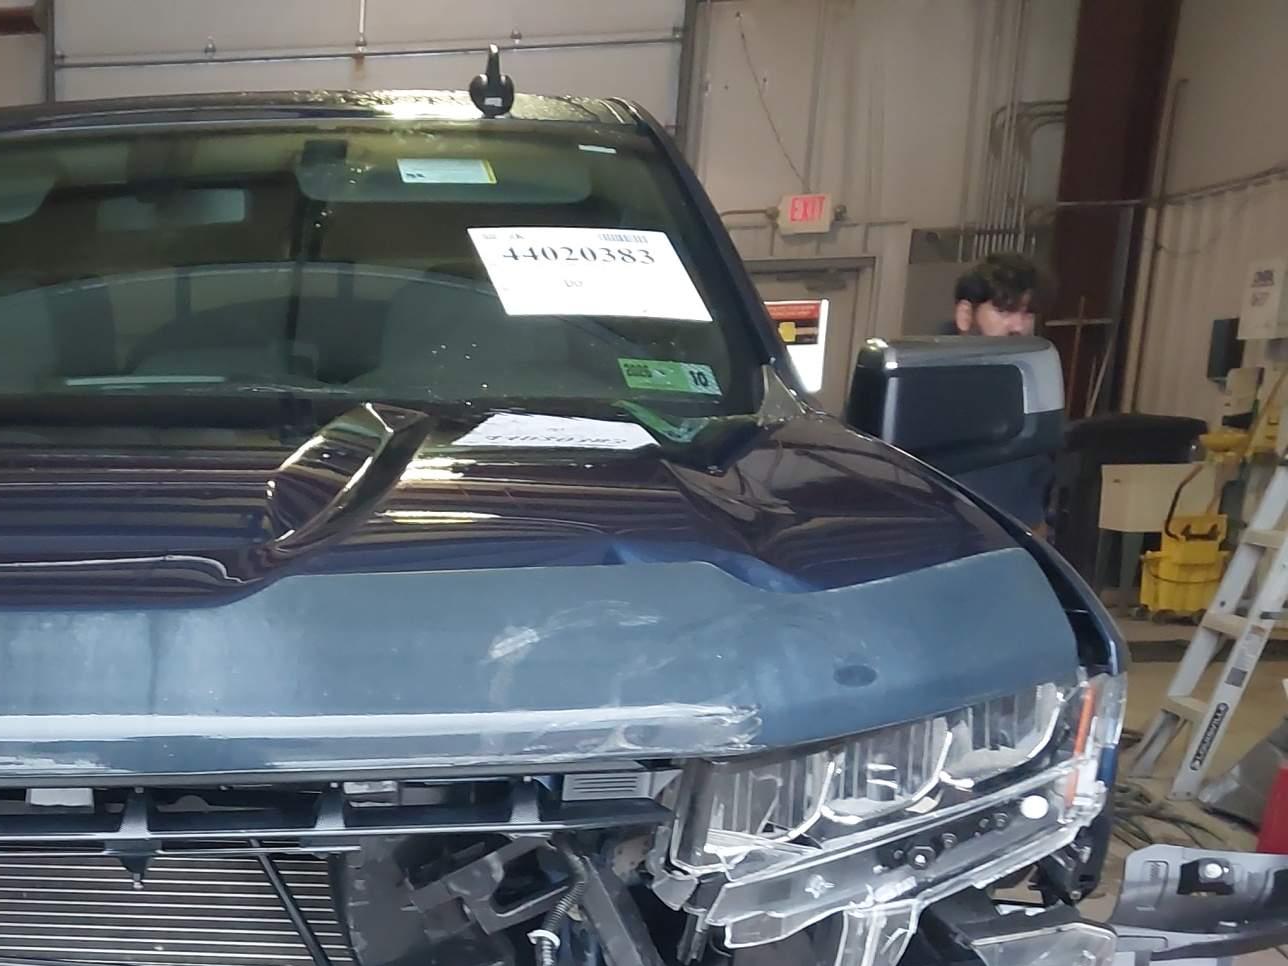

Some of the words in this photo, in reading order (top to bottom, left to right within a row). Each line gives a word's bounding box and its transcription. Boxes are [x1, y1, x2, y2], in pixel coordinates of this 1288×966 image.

[790, 196, 825, 222] EXIT
[503, 246, 657, 264] 44020383
[689, 370, 710, 388] 10
